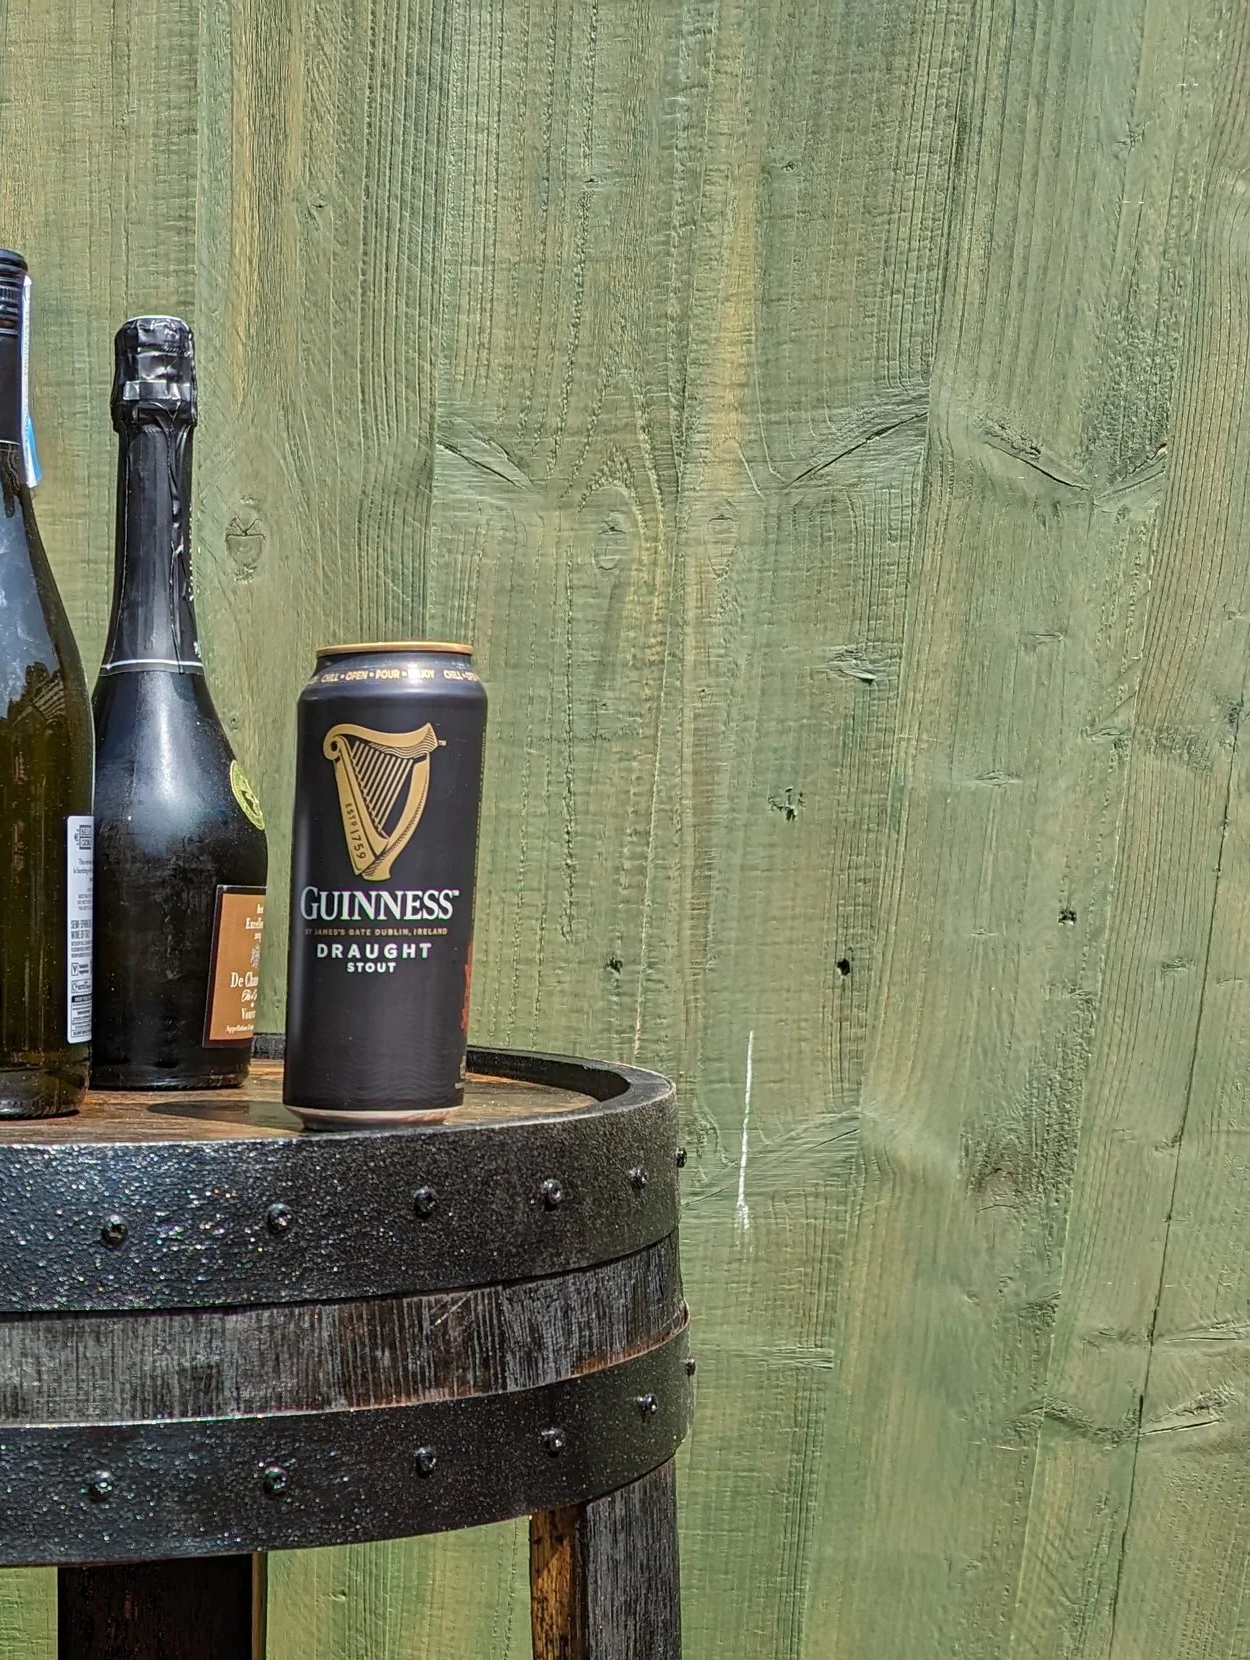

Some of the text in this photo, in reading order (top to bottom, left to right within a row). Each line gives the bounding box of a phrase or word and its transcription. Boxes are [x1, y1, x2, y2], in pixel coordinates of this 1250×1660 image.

[375, 669, 400, 680] POUR
[350, 829, 367, 859] 1759
[300, 886, 454, 921] GUINNESS
[348, 928, 371, 936] GATE
[413, 928, 448, 936] IRELAND
[317, 943, 432, 959] DRAUGHT
[347, 962, 397, 973] STOUT
[230, 972, 243, 988] De
